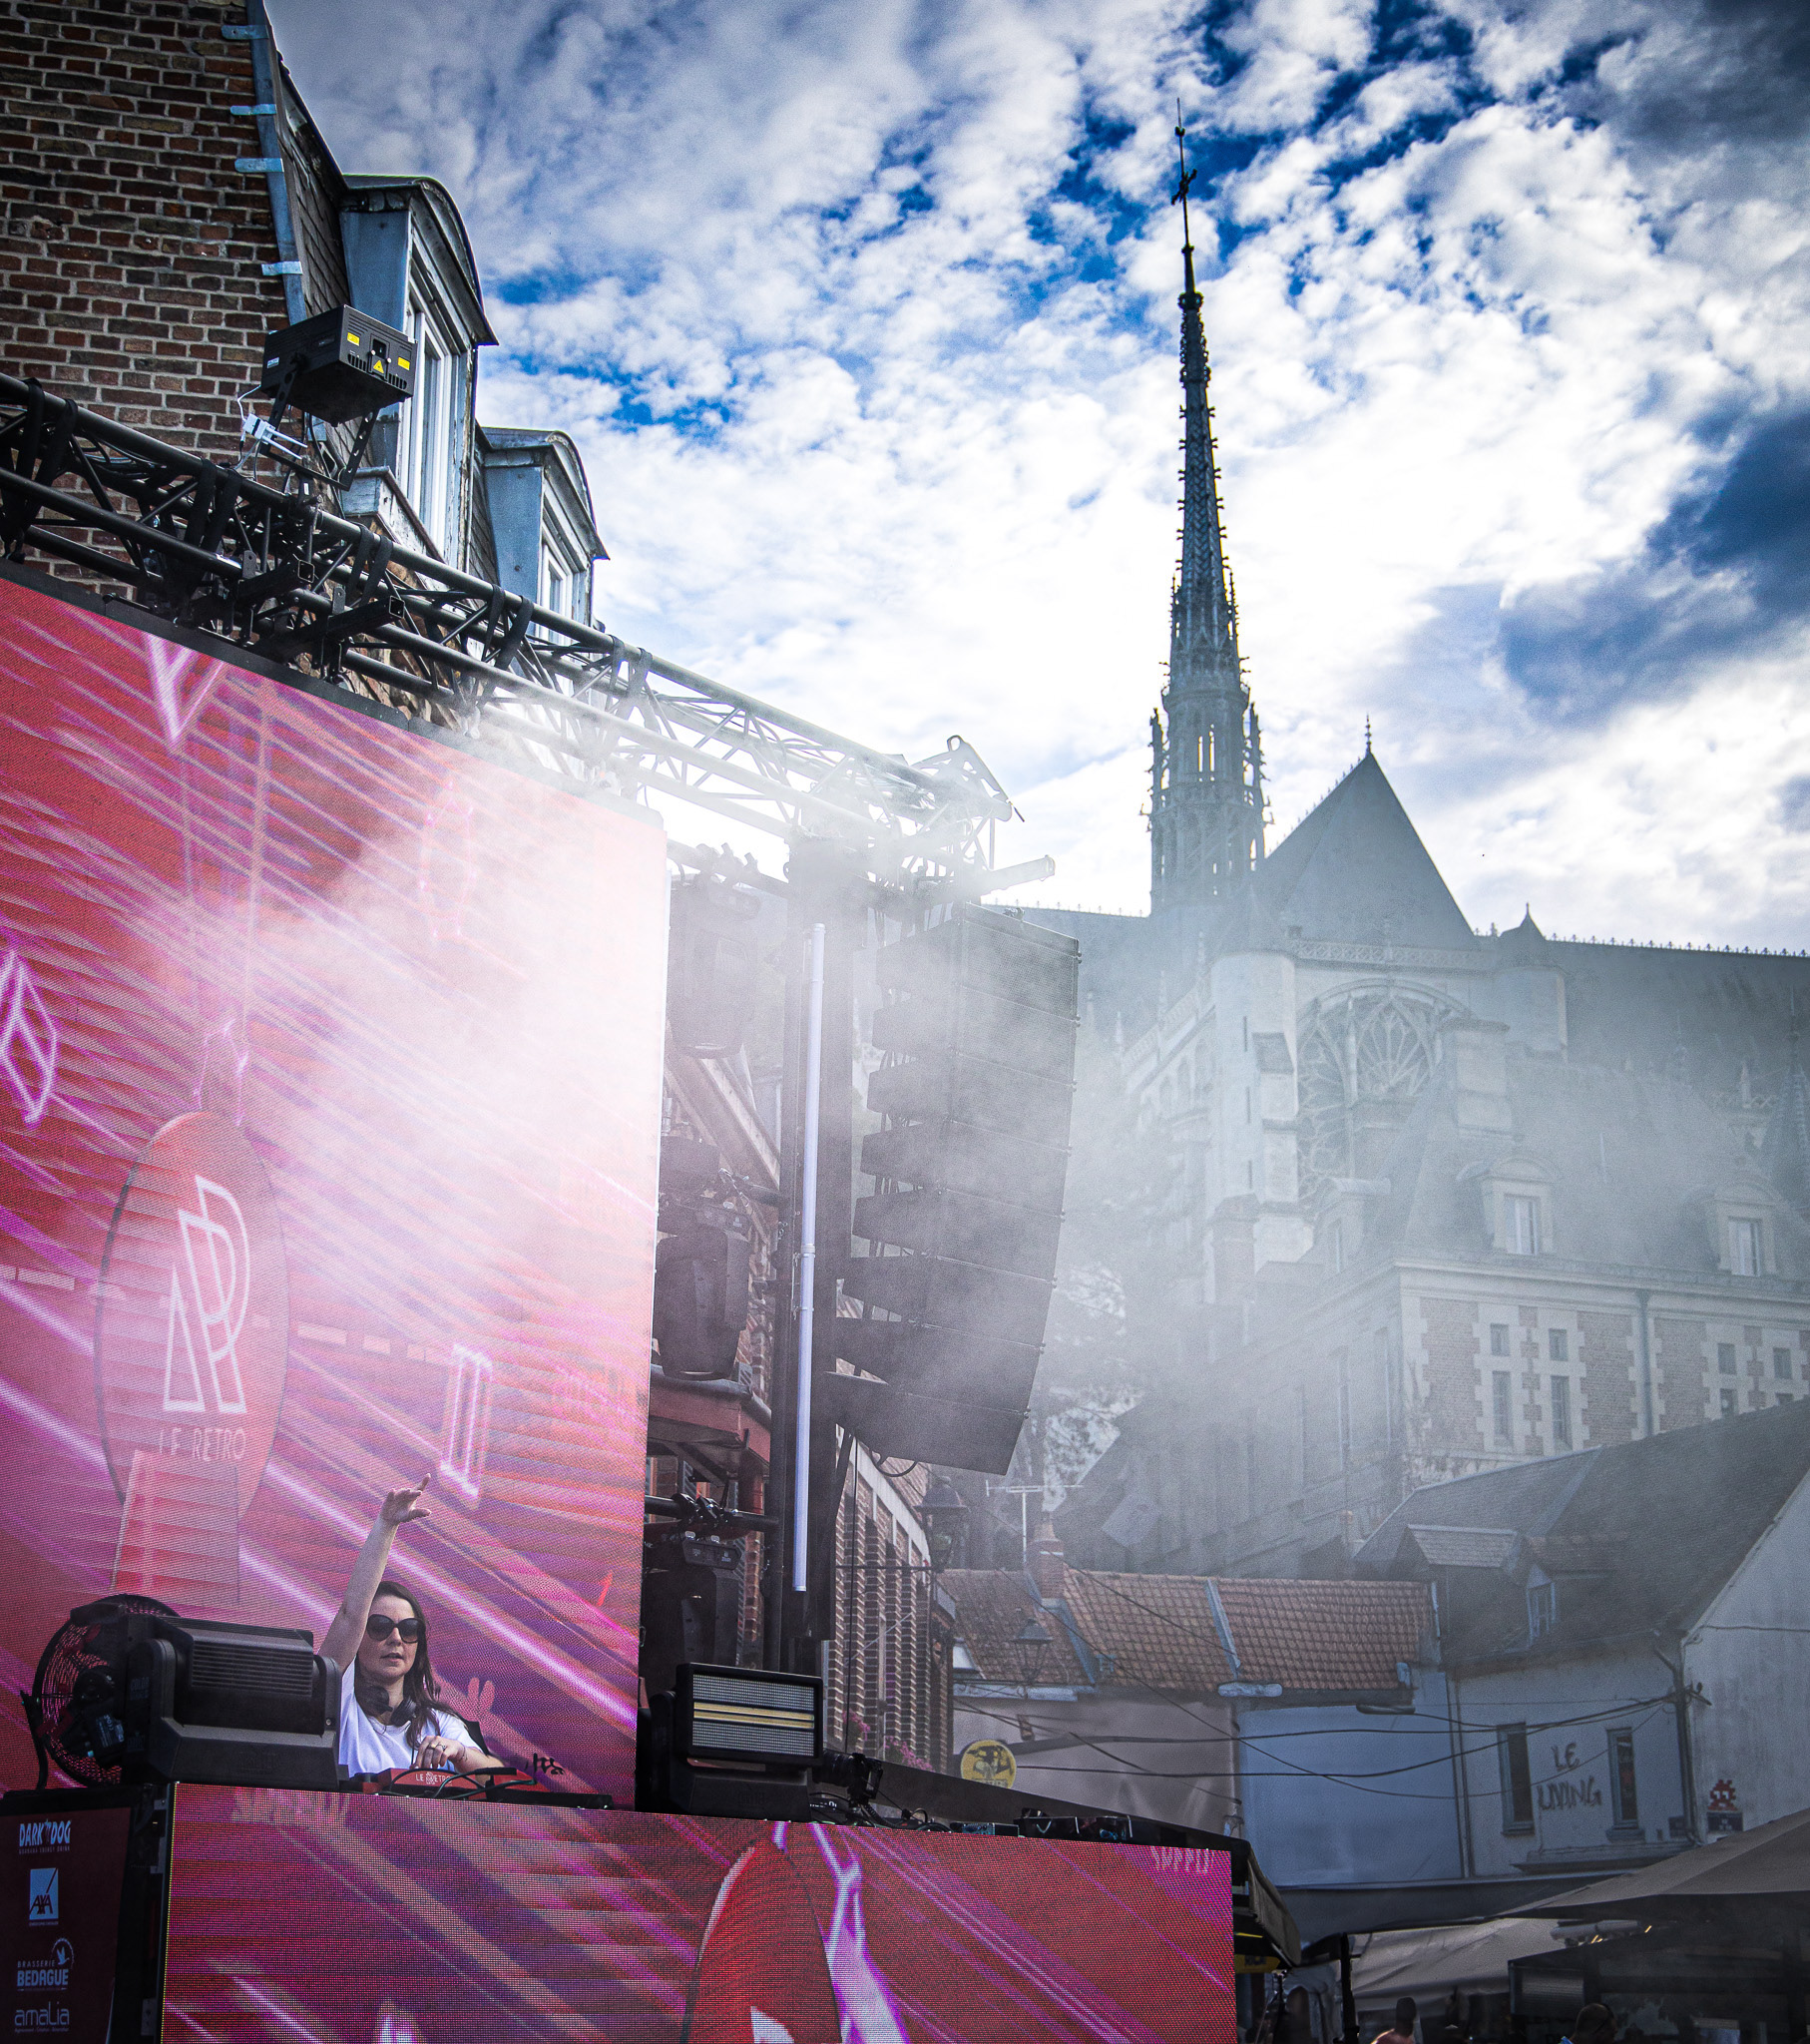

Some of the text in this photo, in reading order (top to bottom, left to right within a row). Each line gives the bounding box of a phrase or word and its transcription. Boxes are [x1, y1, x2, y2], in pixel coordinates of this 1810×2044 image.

[192, 1426, 247, 1462] RETRO
[1551, 1742, 1581, 1772] LE
[415, 1773, 424, 1782] LE
[19, 1818, 72, 1847] DARK DOG
[29, 1893, 54, 1915] AXA
[17, 1959, 56, 1969] BRASSERIE
[16, 1968, 69, 1988] BEDAGUE
